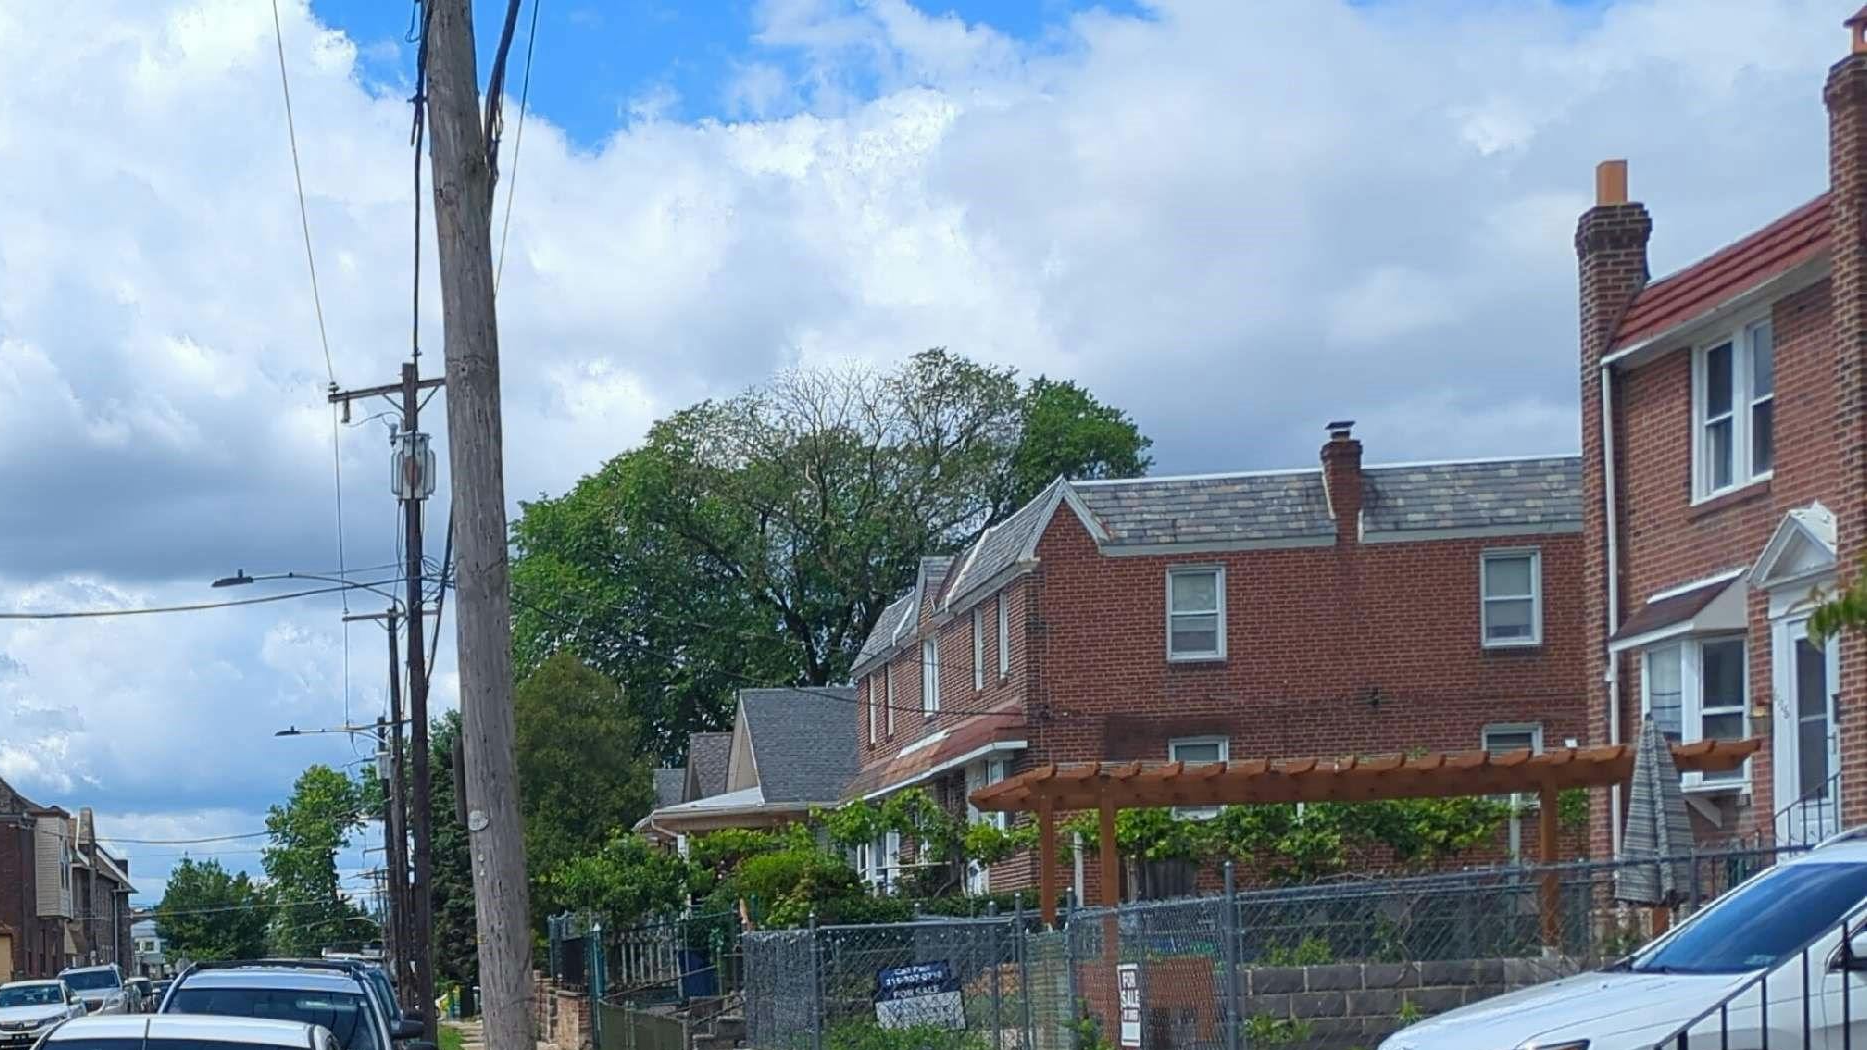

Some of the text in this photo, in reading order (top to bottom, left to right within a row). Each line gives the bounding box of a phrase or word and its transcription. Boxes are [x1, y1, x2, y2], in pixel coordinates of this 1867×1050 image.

[1122, 971, 1136, 989] FOR
[893, 990, 914, 998] FOR
[1121, 989, 1140, 1008] SALE
